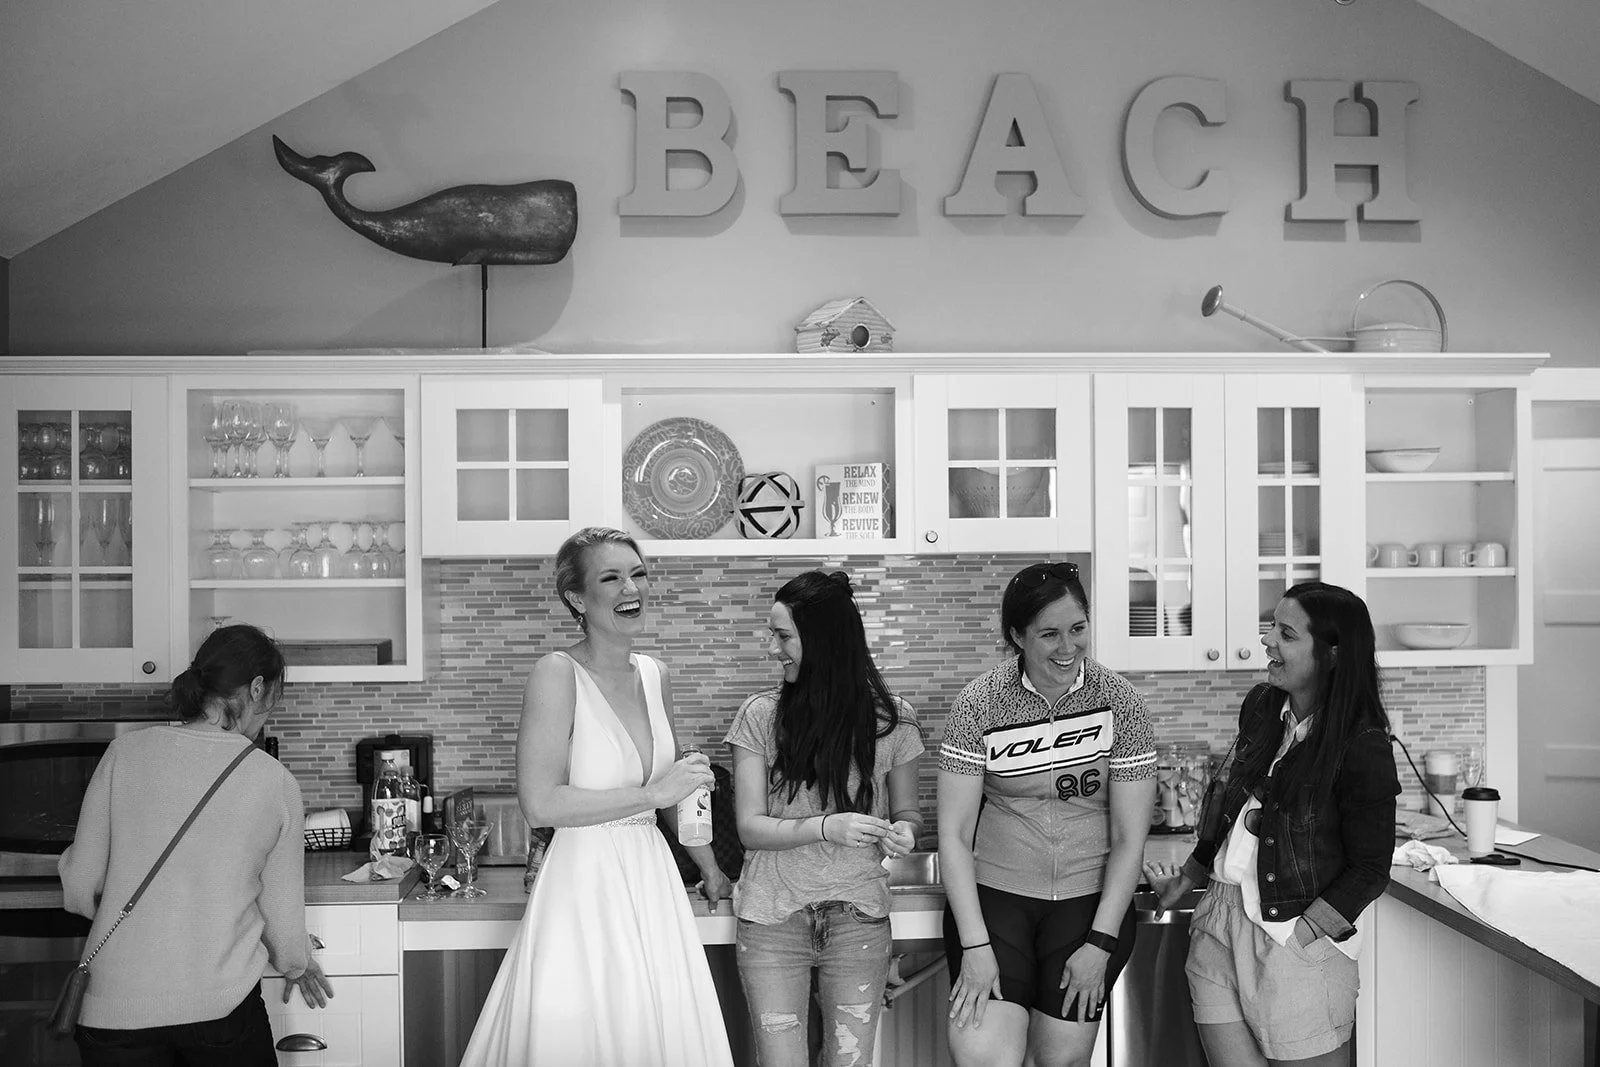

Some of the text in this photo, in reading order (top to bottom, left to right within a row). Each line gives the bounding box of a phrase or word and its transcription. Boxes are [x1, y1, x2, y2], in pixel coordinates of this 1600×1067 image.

[616, 69, 1422, 223] BEACH
[844, 466, 876, 478] RELAX
[845, 479, 858, 488] THE
[842, 492, 879, 505] RENEW
[845, 505, 857, 513] THE
[842, 518, 879, 531] REVIVE
[845, 531, 858, 540] THE
[990, 725, 1103, 760] VOLER
[1055, 768, 1101, 801] 86
